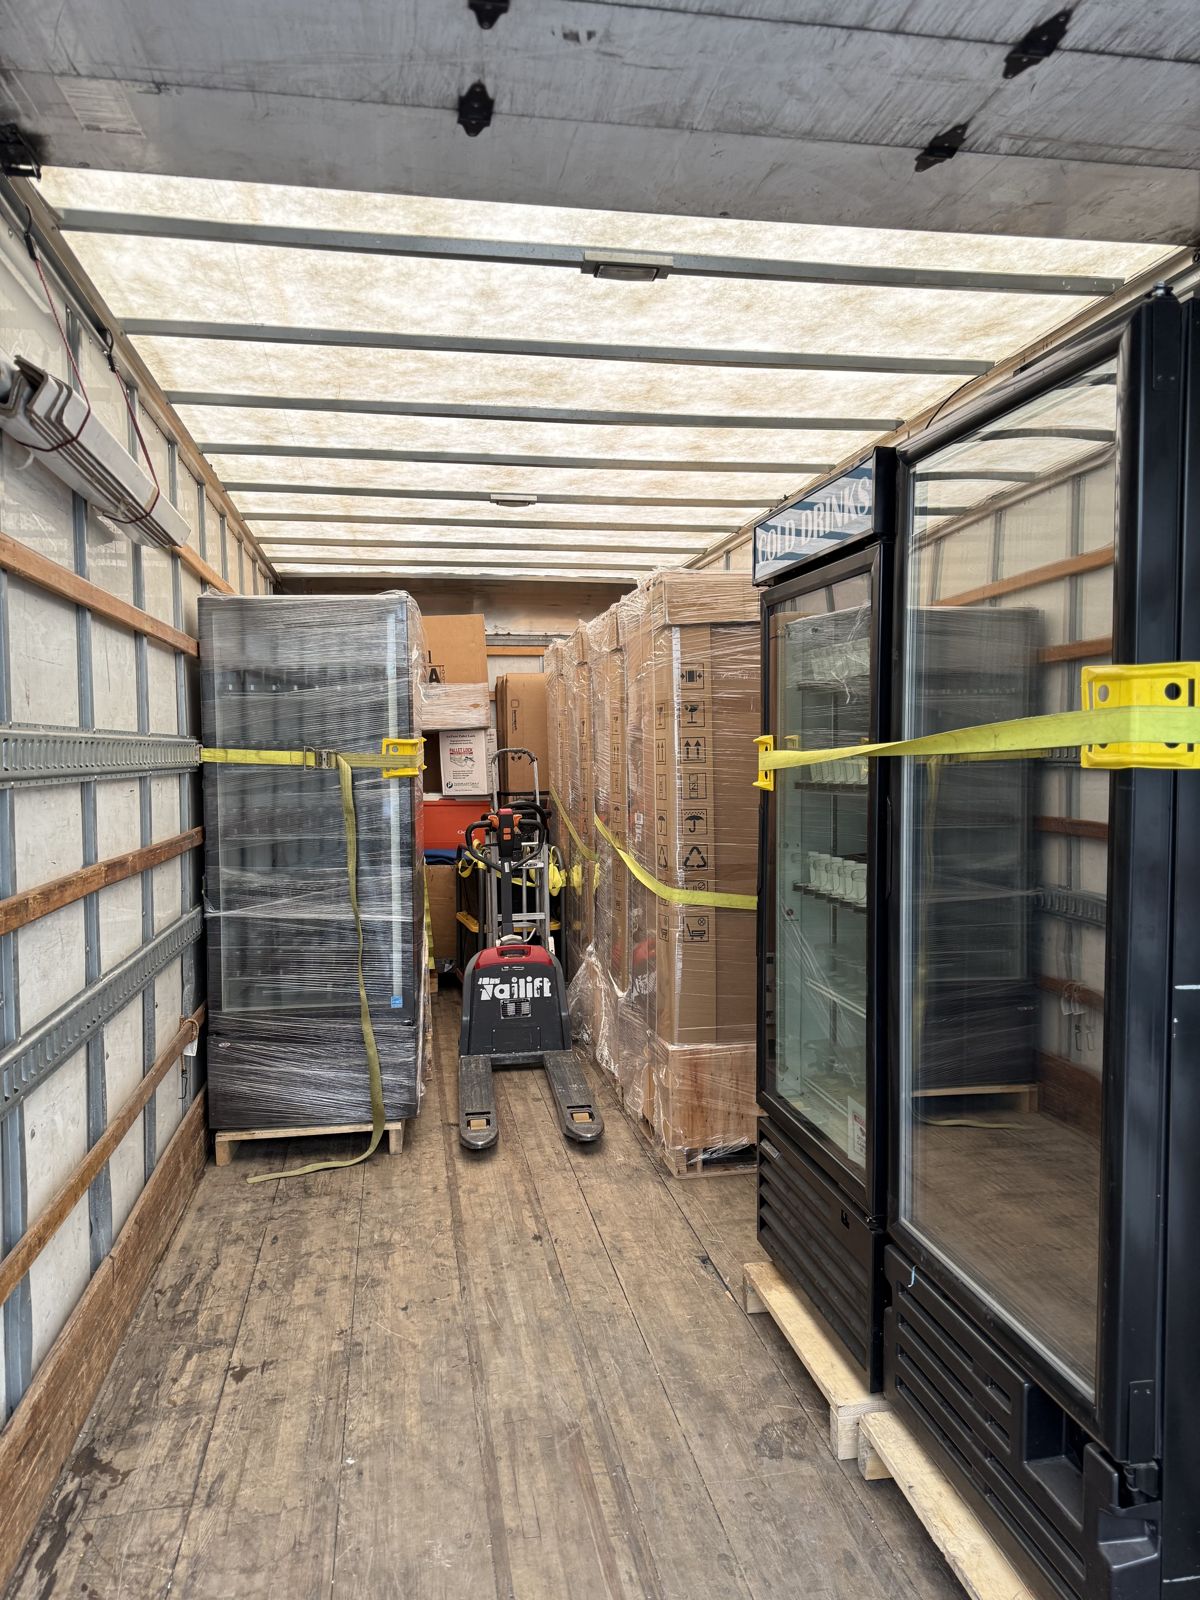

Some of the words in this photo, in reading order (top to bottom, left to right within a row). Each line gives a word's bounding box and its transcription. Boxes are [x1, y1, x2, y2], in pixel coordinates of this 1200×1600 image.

[757, 519, 796, 563] COLD
[801, 476, 870, 546] DRINKS
[478, 976, 552, 1000] Tailift
